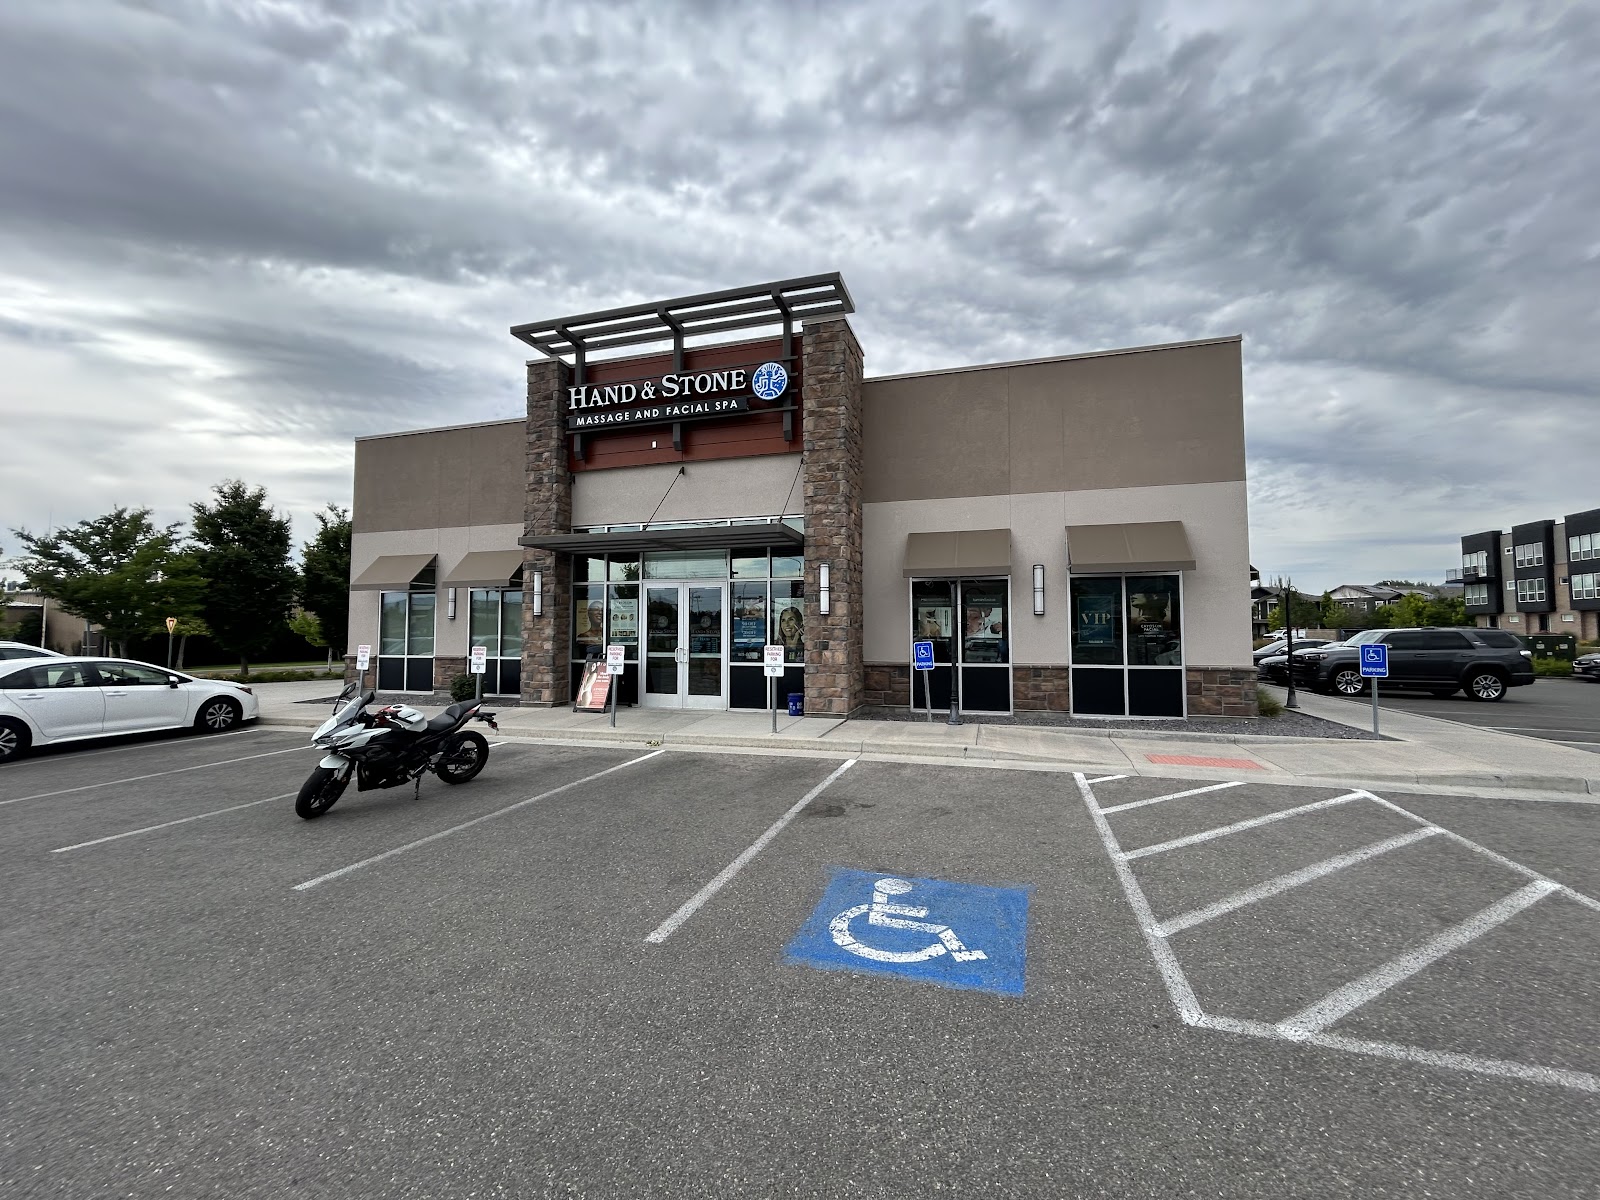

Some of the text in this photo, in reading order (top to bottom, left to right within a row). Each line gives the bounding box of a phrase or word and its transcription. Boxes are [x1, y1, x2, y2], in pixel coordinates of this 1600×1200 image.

[568, 369, 747, 410] HAND & STONE
[576, 399, 738, 426] MASSAGE AND FACIAL SPA
[1081, 613, 1111, 625] VIP
